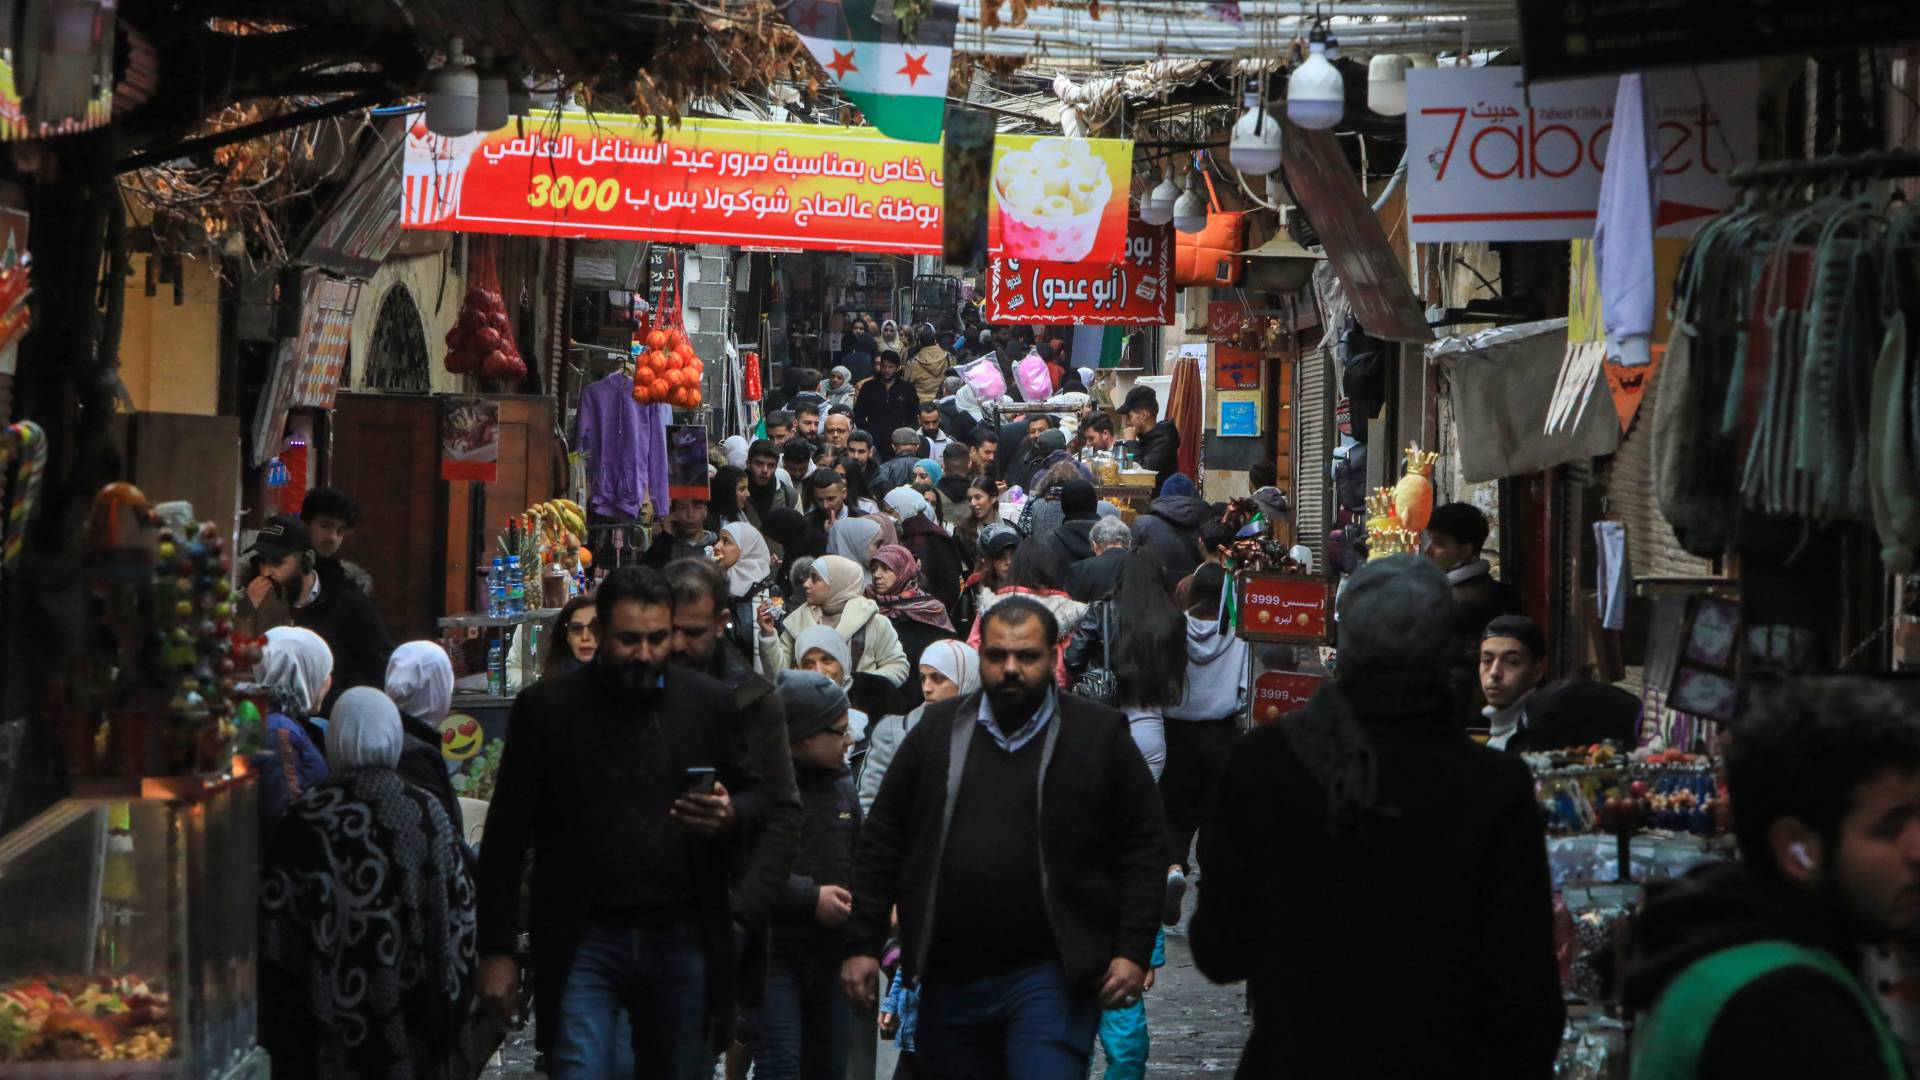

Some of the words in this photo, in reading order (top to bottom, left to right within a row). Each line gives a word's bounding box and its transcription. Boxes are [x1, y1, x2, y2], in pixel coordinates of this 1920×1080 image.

[482, 133, 574, 165] العالمي
[671, 149, 715, 173] عيد
[717, 150, 769, 177] مرور
[772, 148, 865, 183] بمناسبة
[869, 156, 926, 183] خاص
[526, 173, 621, 213] 3000
[624, 186, 650, 211] ب
[653, 188, 698, 214] بس
[702, 186, 790, 219] شوكولا
[794, 191, 873, 227] عالصاج
[877, 196, 939, 230] بوظة
